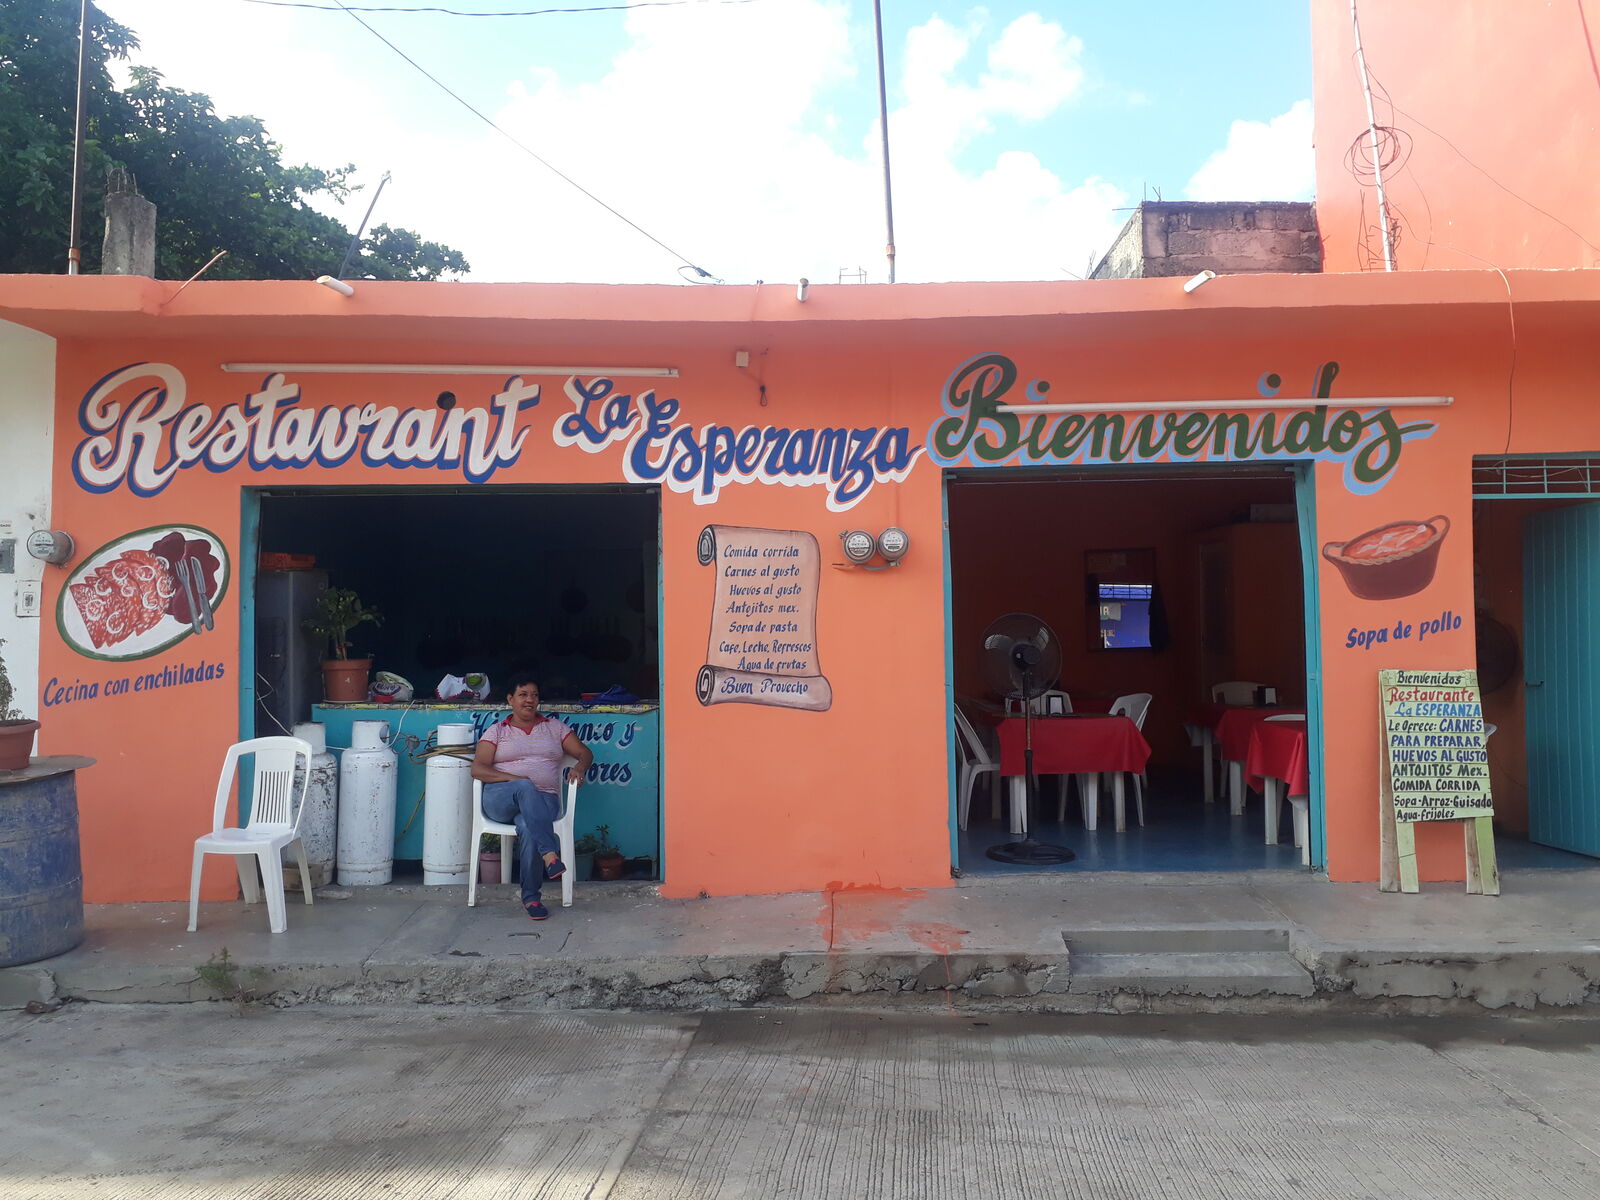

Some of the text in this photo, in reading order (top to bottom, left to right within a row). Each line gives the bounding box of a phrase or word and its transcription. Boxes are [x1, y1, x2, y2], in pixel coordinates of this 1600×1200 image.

[926, 352, 1439, 495] Bienvenidos
[72, 362, 926, 512] Restaurant La Esperanza
[723, 544, 799, 558] Comida corrida
[724, 563, 800, 580] Carnes al gusto
[729, 582, 802, 599] Huevos al gusto
[725, 600, 800, 618] Antojitos mex.
[728, 620, 798, 634] Sopa de pasta
[1345, 610, 1462, 650] Sopa de pollo
[772, 639, 812, 654] Refrescos
[737, 655, 807, 673] Agua de frutas
[43, 660, 226, 707] Cecina con enchiladas
[720, 676, 809, 695] Buen Provecho
[1397, 670, 1463, 685] Bienvenidos
[1387, 686, 1475, 706] Restaurante
[1394, 701, 1481, 717] La ESPERANZA
[617, 721, 637, 748] y
[1388, 718, 1483, 734] Le Ofrece: CARNES
[1391, 734, 1421, 747] PARA
[1392, 749, 1487, 763] HUEVOS AL GUSTO
[1392, 763, 1488, 776] ANTOJITOS Mex.
